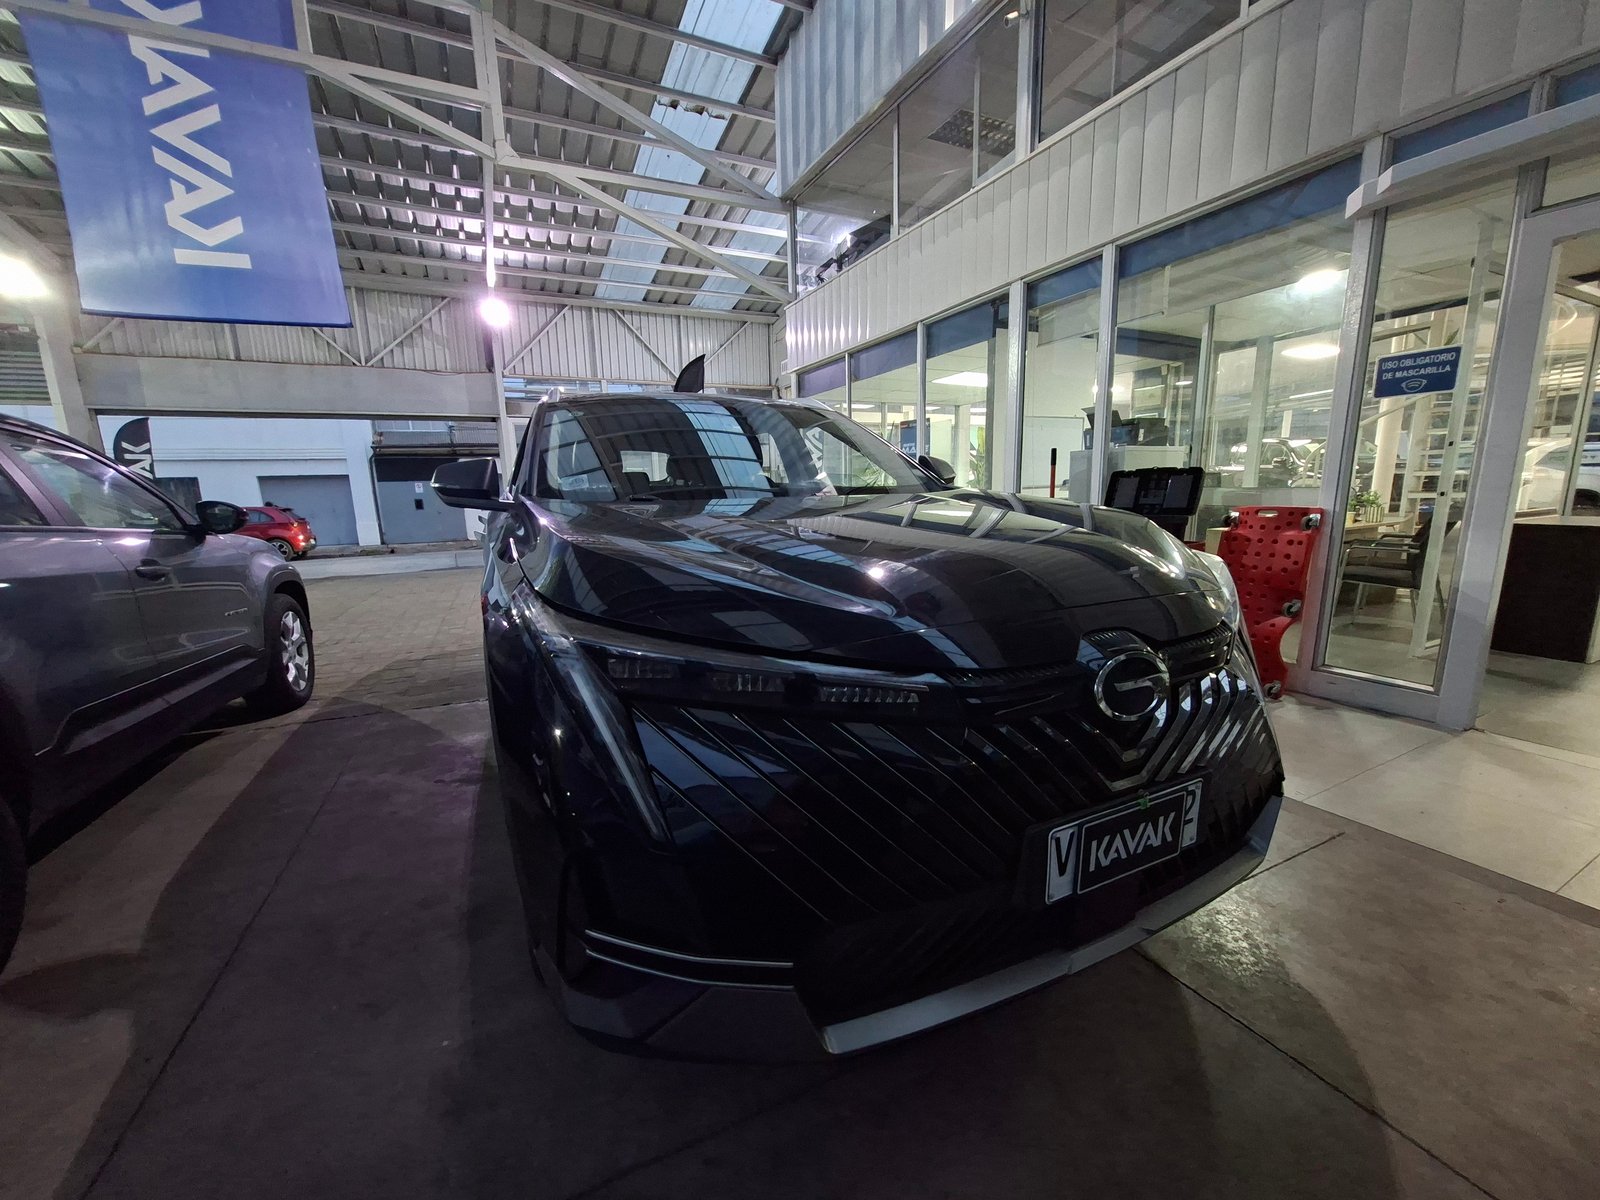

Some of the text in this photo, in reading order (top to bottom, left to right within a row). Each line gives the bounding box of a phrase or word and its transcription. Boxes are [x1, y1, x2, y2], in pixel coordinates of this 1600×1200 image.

[1382, 352, 1455, 369] USO OBLIGATORIO
[1382, 365, 1450, 380] DE MASCARILLA
[1089, 812, 1175, 872] KAVAK
